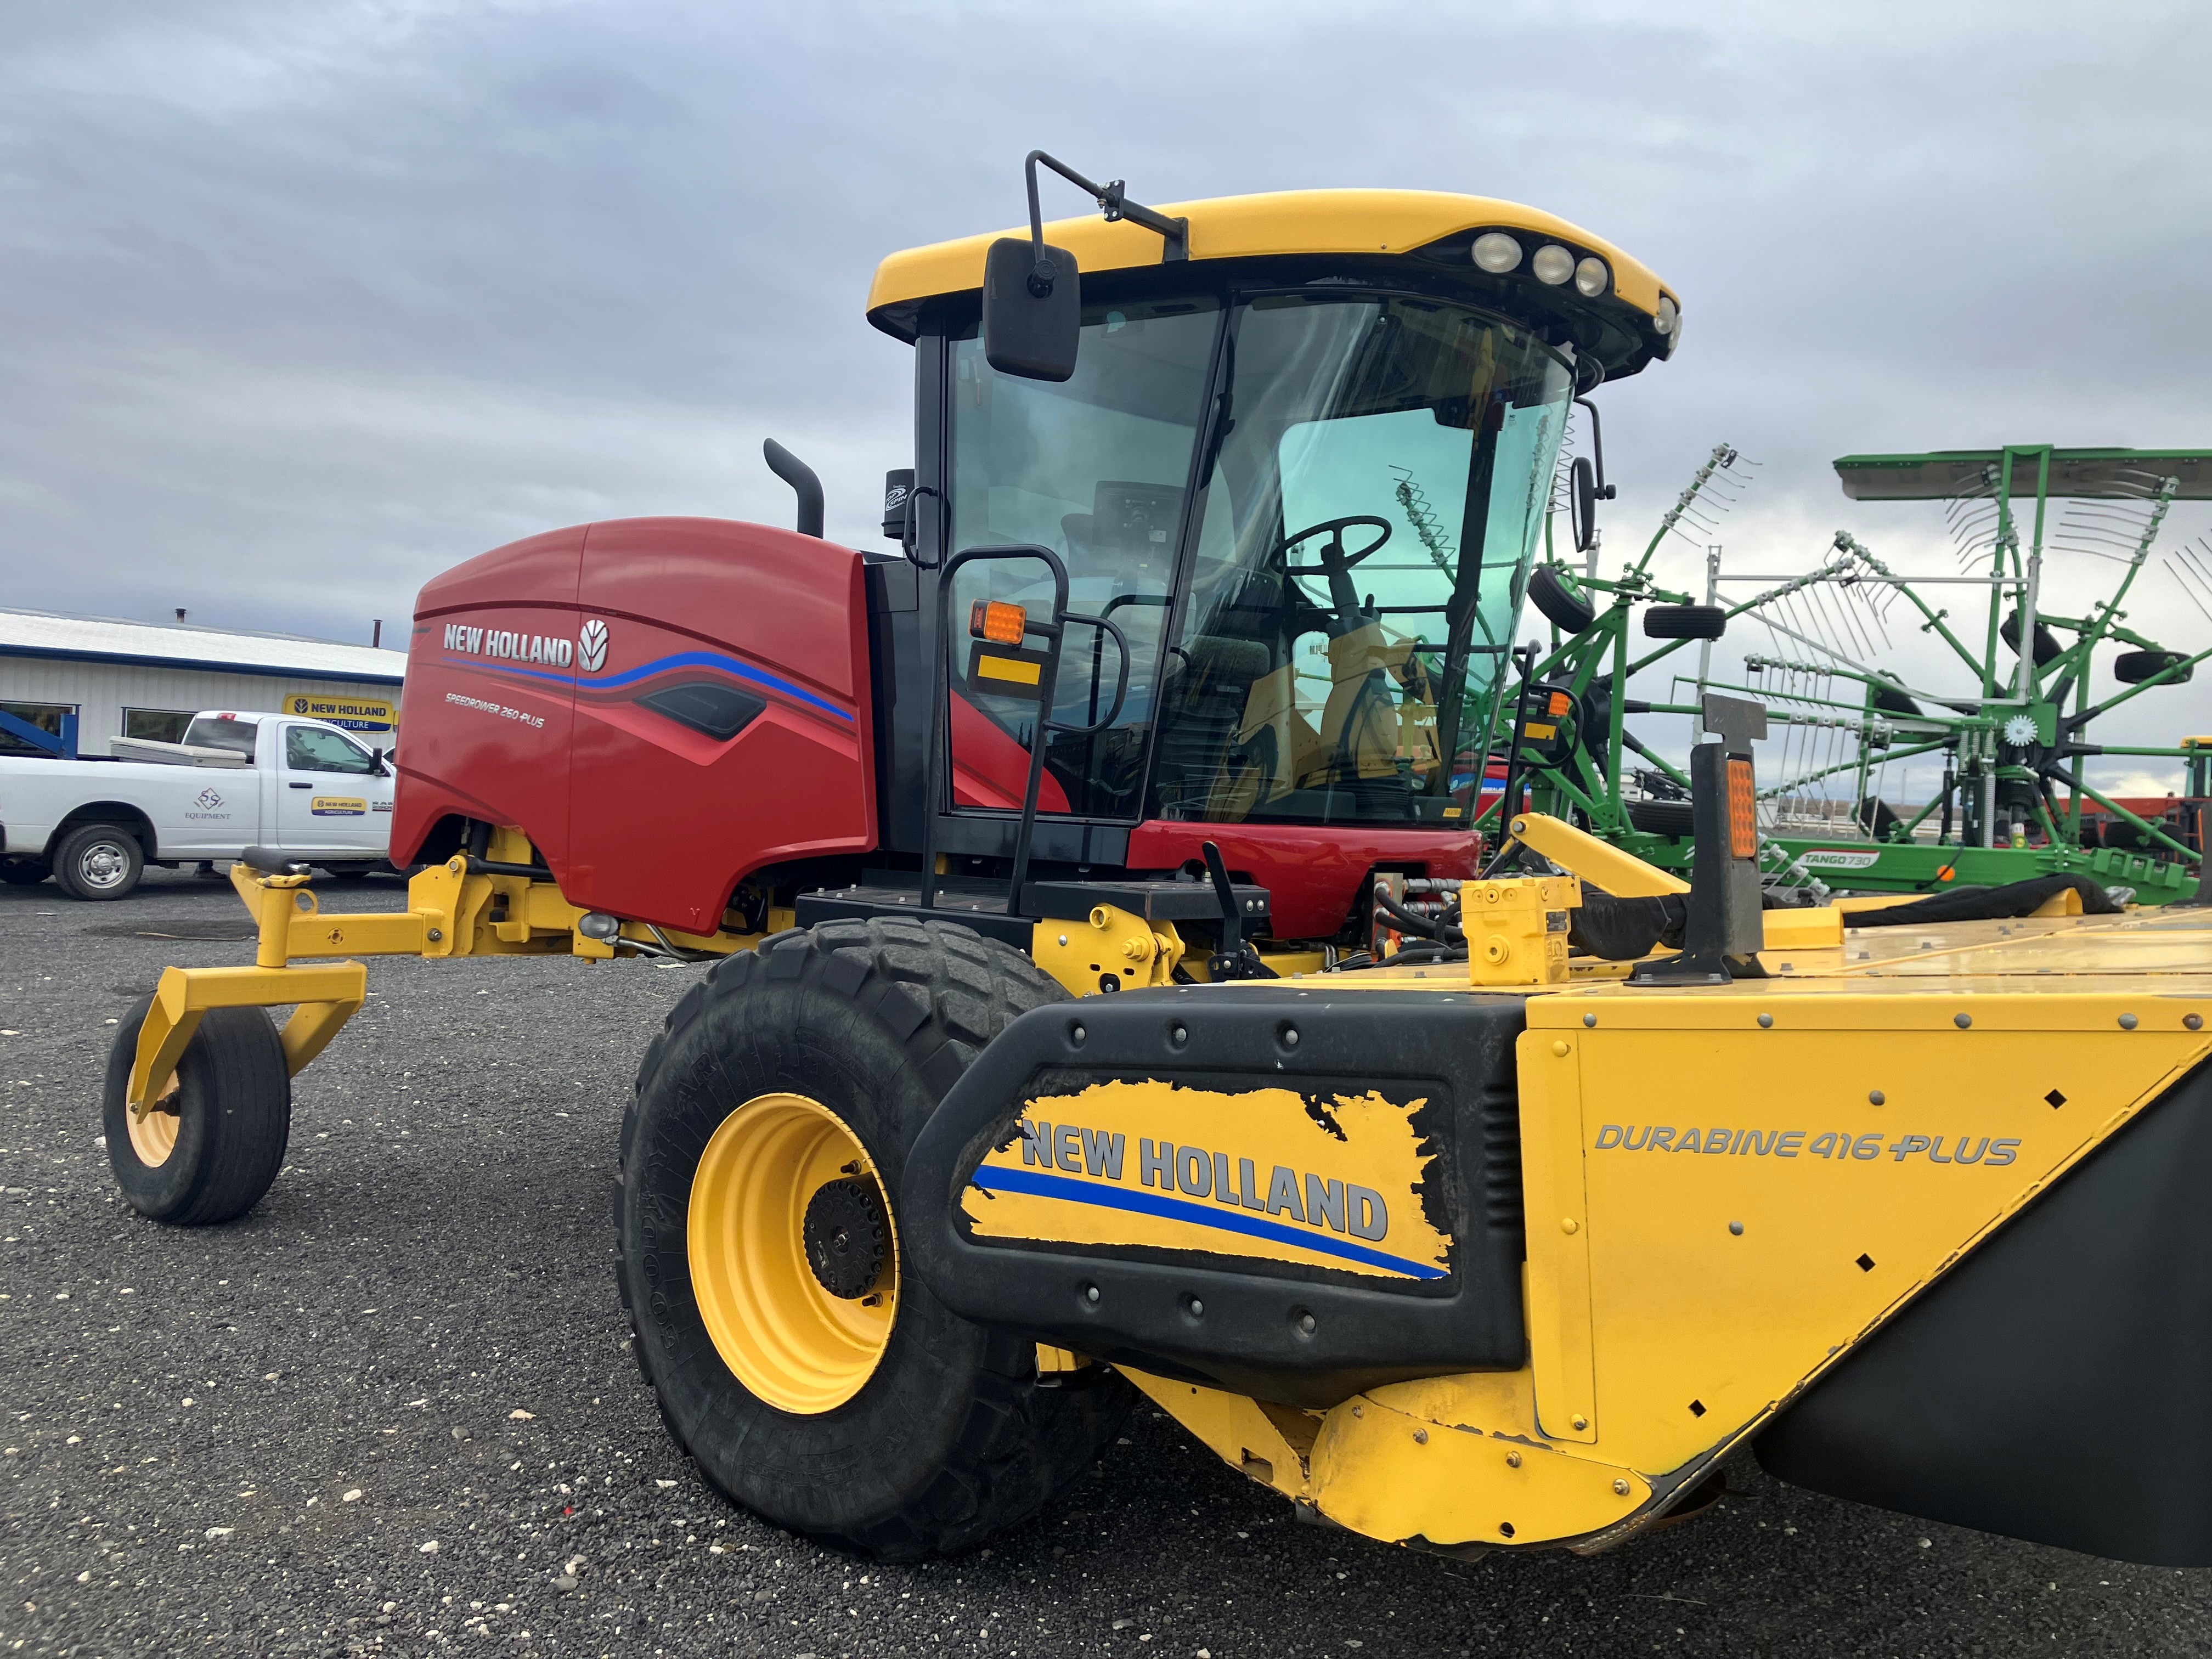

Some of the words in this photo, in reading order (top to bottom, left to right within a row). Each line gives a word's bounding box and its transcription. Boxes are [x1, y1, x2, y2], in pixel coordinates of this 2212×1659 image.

[444, 623, 484, 654] NEW
[486, 629, 574, 668] HOLLAND
[311, 703, 336, 713] NEW
[338, 705, 386, 716] HOLLAND
[445, 692, 500, 715] SPEEDROWER
[500, 707, 520, 720] 260
[1805, 854, 1846, 864] TANGO
[1847, 856, 1871, 866] 730
[1594, 1124, 1807, 1158] DURABINE
[1809, 1132, 1884, 1160] 416
[1022, 1119, 1125, 1181] NEW
[1139, 1137, 1389, 1242] HOLLAND
